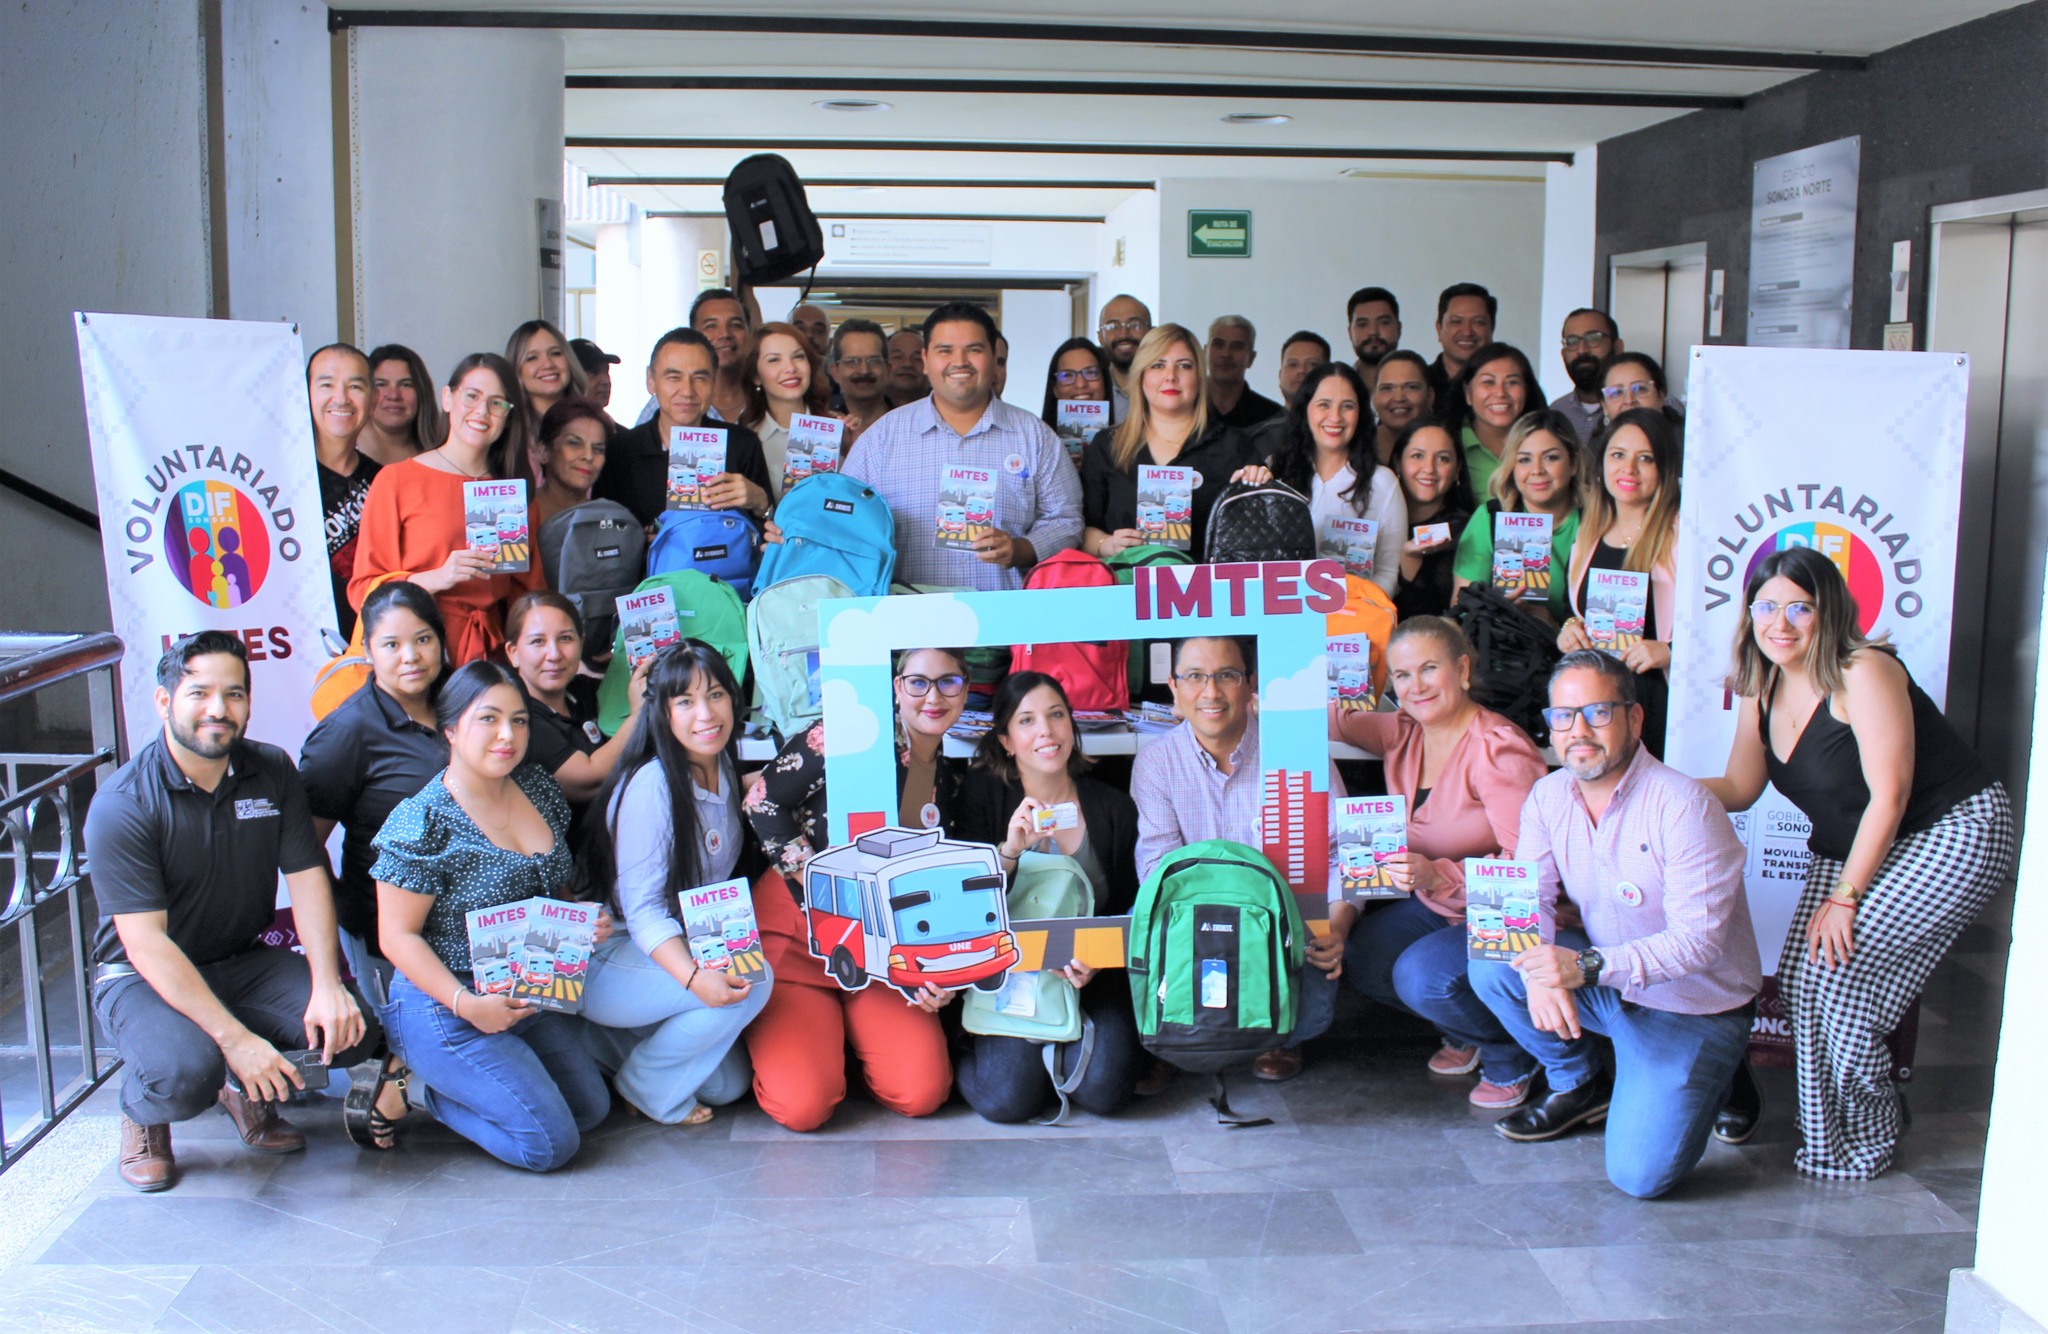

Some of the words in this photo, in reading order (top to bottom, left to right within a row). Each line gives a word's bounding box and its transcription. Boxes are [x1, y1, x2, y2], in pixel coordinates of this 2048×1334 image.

[1767, 187, 1800, 204] SONORA
[1803, 179, 1832, 196] NORTE
[1065, 403, 1101, 414] IMTES
[798, 418, 835, 433] IMTES
[679, 431, 718, 443] IMTES
[950, 468, 989, 482] IMTES
[1146, 469, 1185, 480] IMTES
[473, 485, 517, 497] IMTES
[126, 444, 302, 575] VOLUNTARIADO
[184, 491, 231, 516] DIF
[188, 516, 234, 524] SONORA
[1331, 519, 1370, 533] IMTES
[1504, 516, 1544, 527] IMTES
[1704, 483, 1923, 618] VOLUNTARIADO
[1597, 573, 1638, 587] IMTES
[1135, 559, 1346, 620] IMTES
[625, 592, 665, 611] IMTES
[161, 626, 292, 661] IES
[1326, 642, 1360, 653] MTES
[1346, 801, 1394, 815] IMTES
[1777, 822, 1811, 833] SONO
[1764, 848, 1812, 859] MOVILID
[1475, 864, 1527, 879] IMTES
[1763, 859, 1809, 870] TRANSP
[1762, 870, 1775, 879] EL
[1779, 871, 1807, 881] ESTA
[690, 886, 739, 907] IMTES
[477, 906, 527, 928] IMTES
[541, 904, 588, 923] IMTES
[949, 942, 972, 952] UNE
